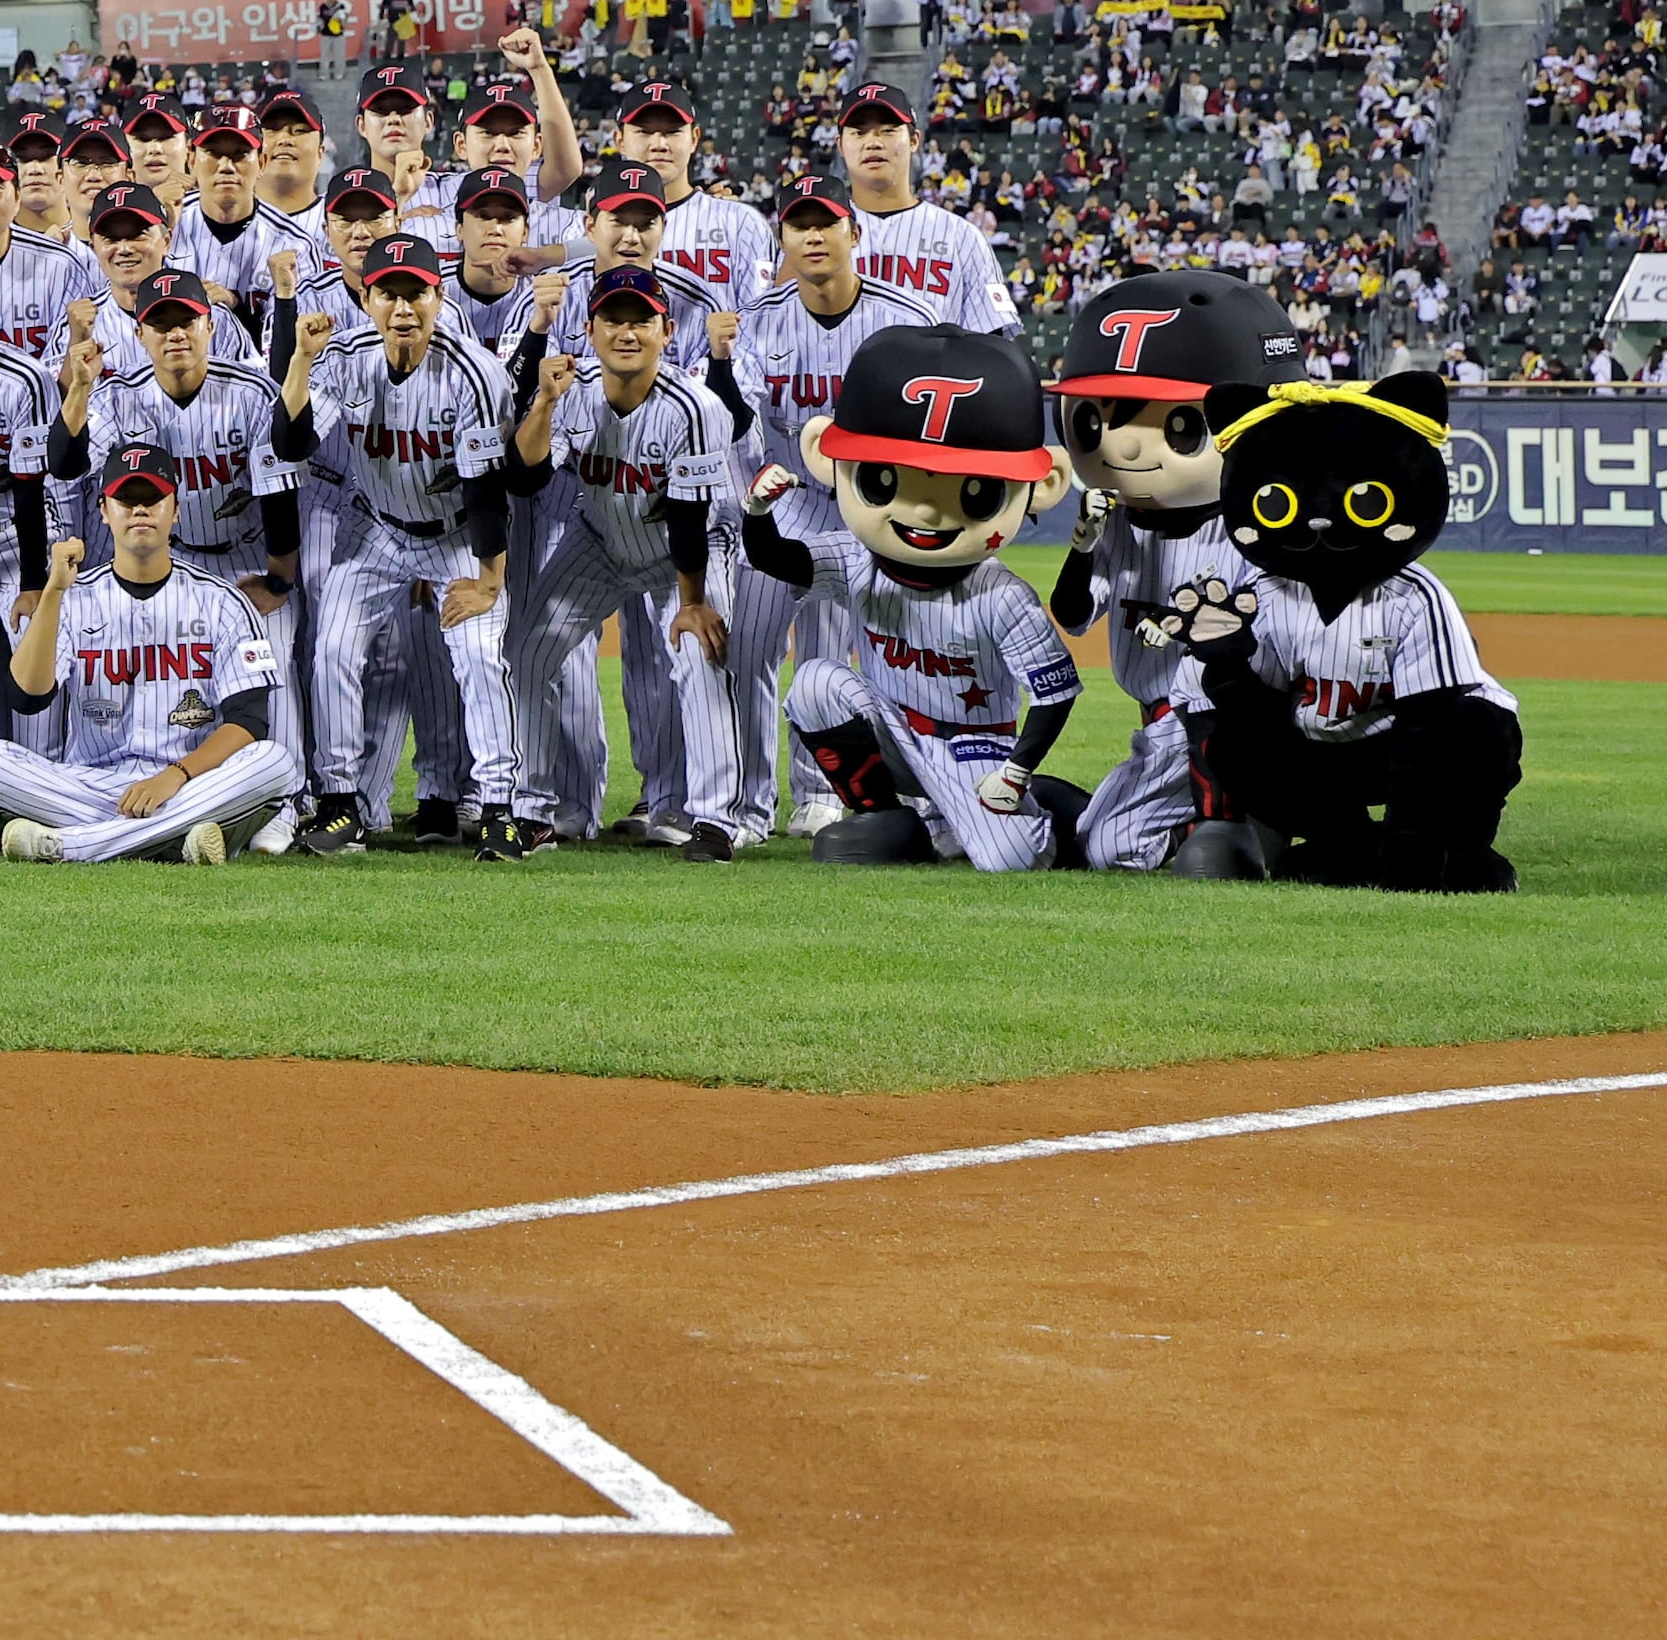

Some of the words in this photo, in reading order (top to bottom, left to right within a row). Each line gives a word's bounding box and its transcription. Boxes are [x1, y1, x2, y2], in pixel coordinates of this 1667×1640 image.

[643, 83, 672, 101] T
[858, 85, 887, 101] T
[620, 169, 647, 190] T
[795, 176, 823, 196] T
[697, 229, 724, 243] LG
[384, 241, 414, 263] T
[920, 238, 948, 255] LG
[152, 274, 181, 297] T
[13, 304, 40, 321] LG
[1099, 308, 1180, 372] T
[428, 407, 455, 425] LG
[901, 376, 984, 442] T
[215, 429, 242, 447] LG
[482, 438, 499, 448] LG
[121, 449, 150, 470] T
[691, 467, 708, 476] LG
[1507, 427, 1667, 528] 대보
[176, 619, 205, 638] LG
[863, 626, 976, 678] TWINS
[78, 642, 212, 686] TWINS
